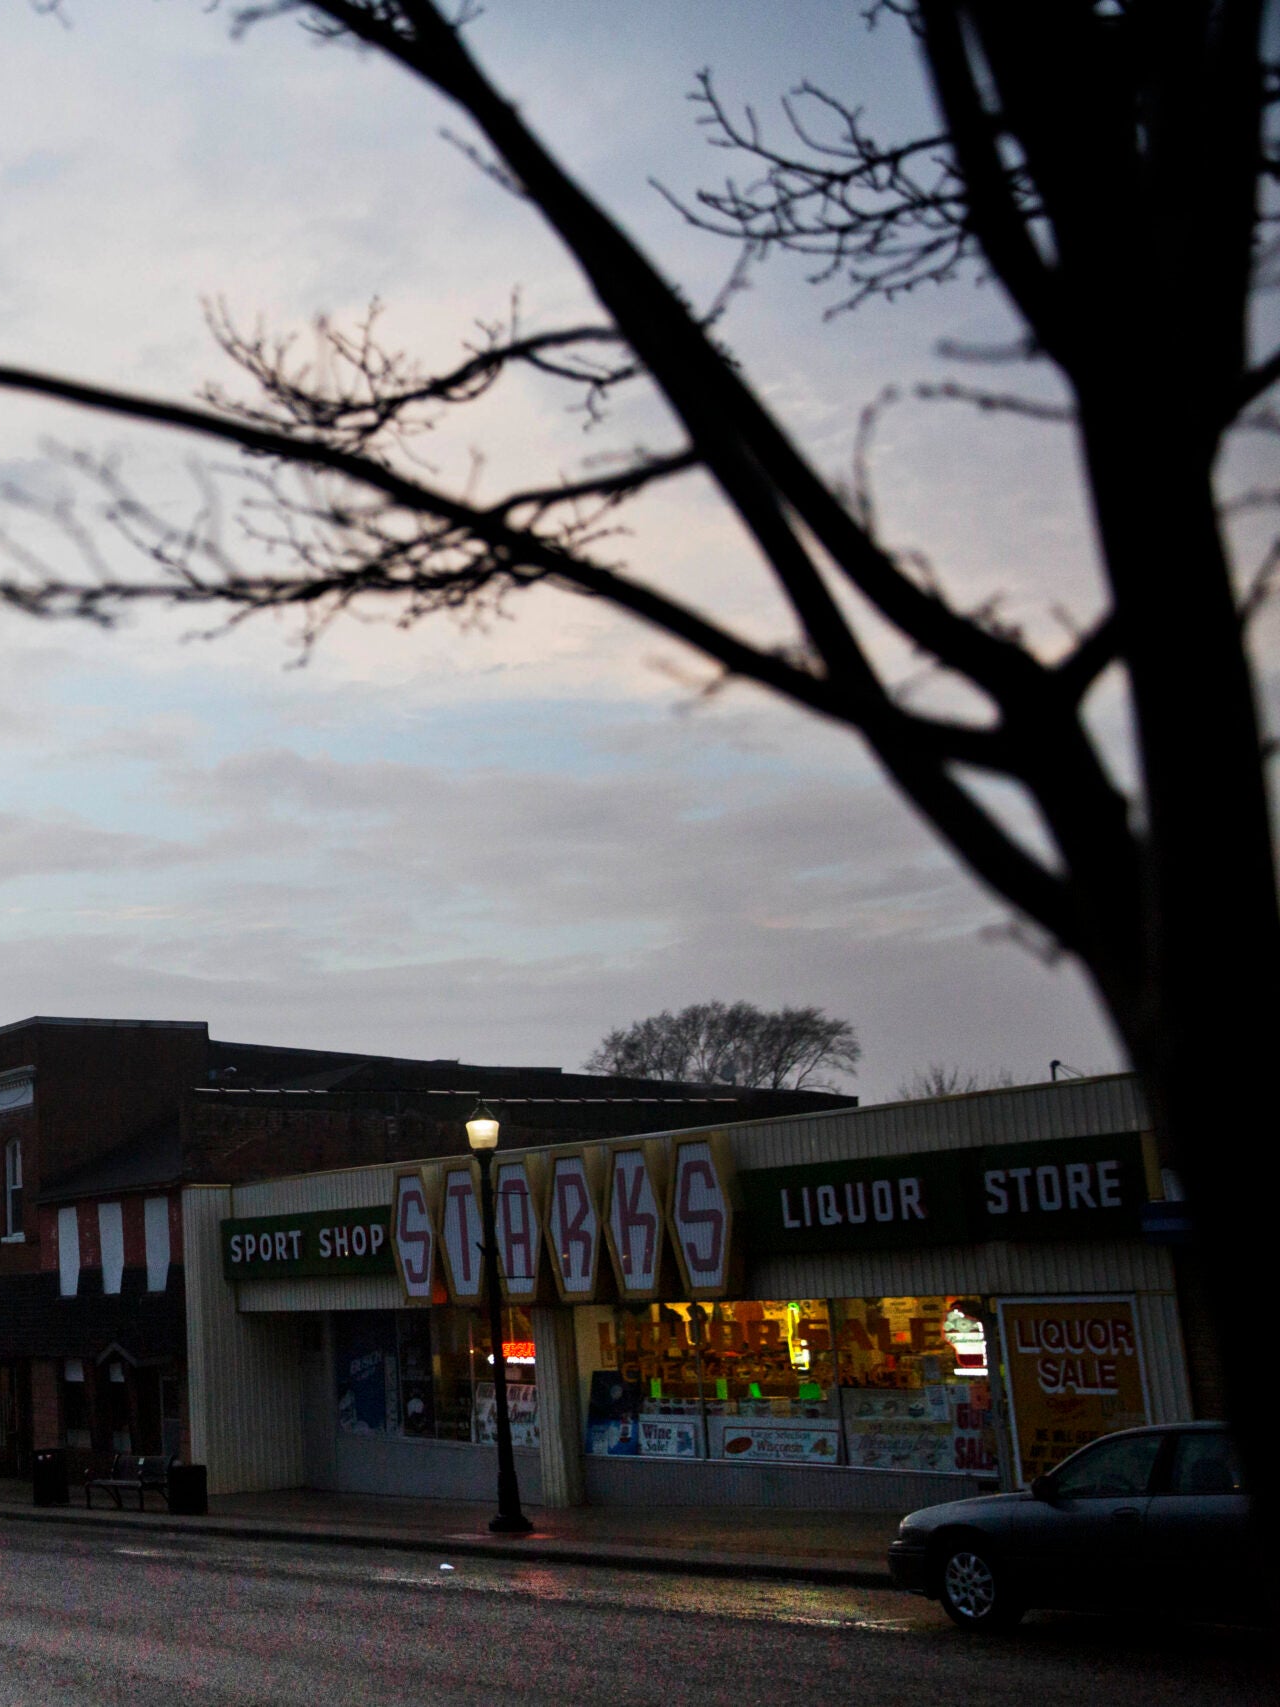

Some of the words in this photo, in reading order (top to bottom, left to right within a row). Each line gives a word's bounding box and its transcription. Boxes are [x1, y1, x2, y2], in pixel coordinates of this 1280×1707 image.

[780, 1177, 926, 1229] LIQUOR
[983, 1160, 1122, 1215] STORE
[400, 1160, 724, 1284] STARKS
[230, 1230, 302, 1263] SPORT
[319, 1223, 384, 1258] SHOP
[797, 1317, 946, 1351] SALE
[1016, 1319, 1134, 1356] LIQUOR
[1038, 1359, 1120, 1394] SALE
[642, 1424, 671, 1439] Wine
[757, 1439, 803, 1452] Wisconsin
